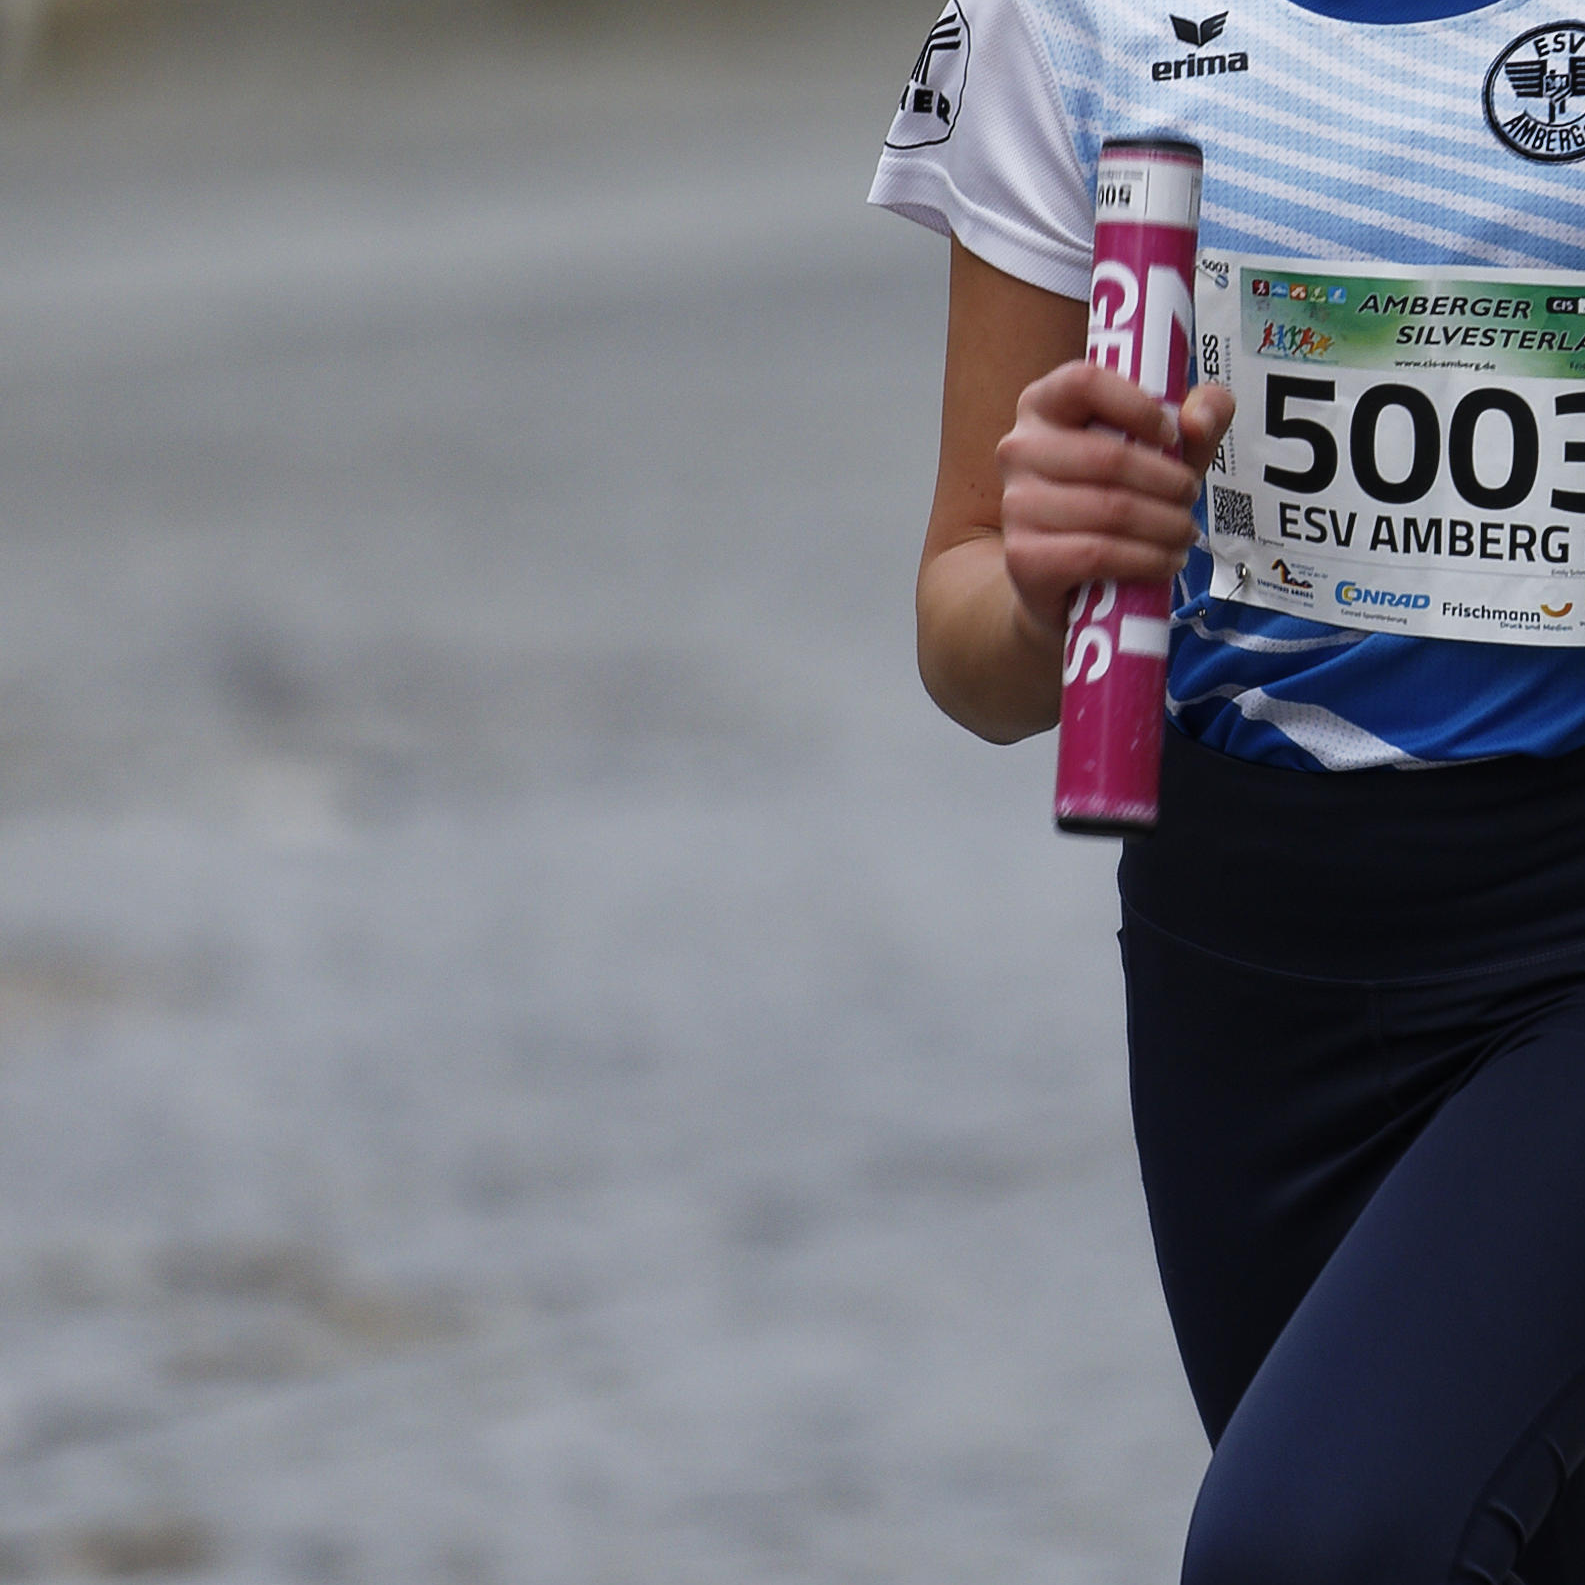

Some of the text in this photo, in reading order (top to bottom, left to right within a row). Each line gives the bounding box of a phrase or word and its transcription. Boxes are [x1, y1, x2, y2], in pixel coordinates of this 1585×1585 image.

[1152, 52, 1248, 81] erima
[1503, 114, 1585, 153] AMBERG
[1358, 294, 1532, 319] AMBERGER
[1552, 300, 1575, 312] CIS
[1279, 501, 1357, 548] ESV
[1369, 515, 1570, 564] AMBERG
[1335, 581, 1430, 610] CONRAD
[1442, 602, 1541, 623] Frischmann
